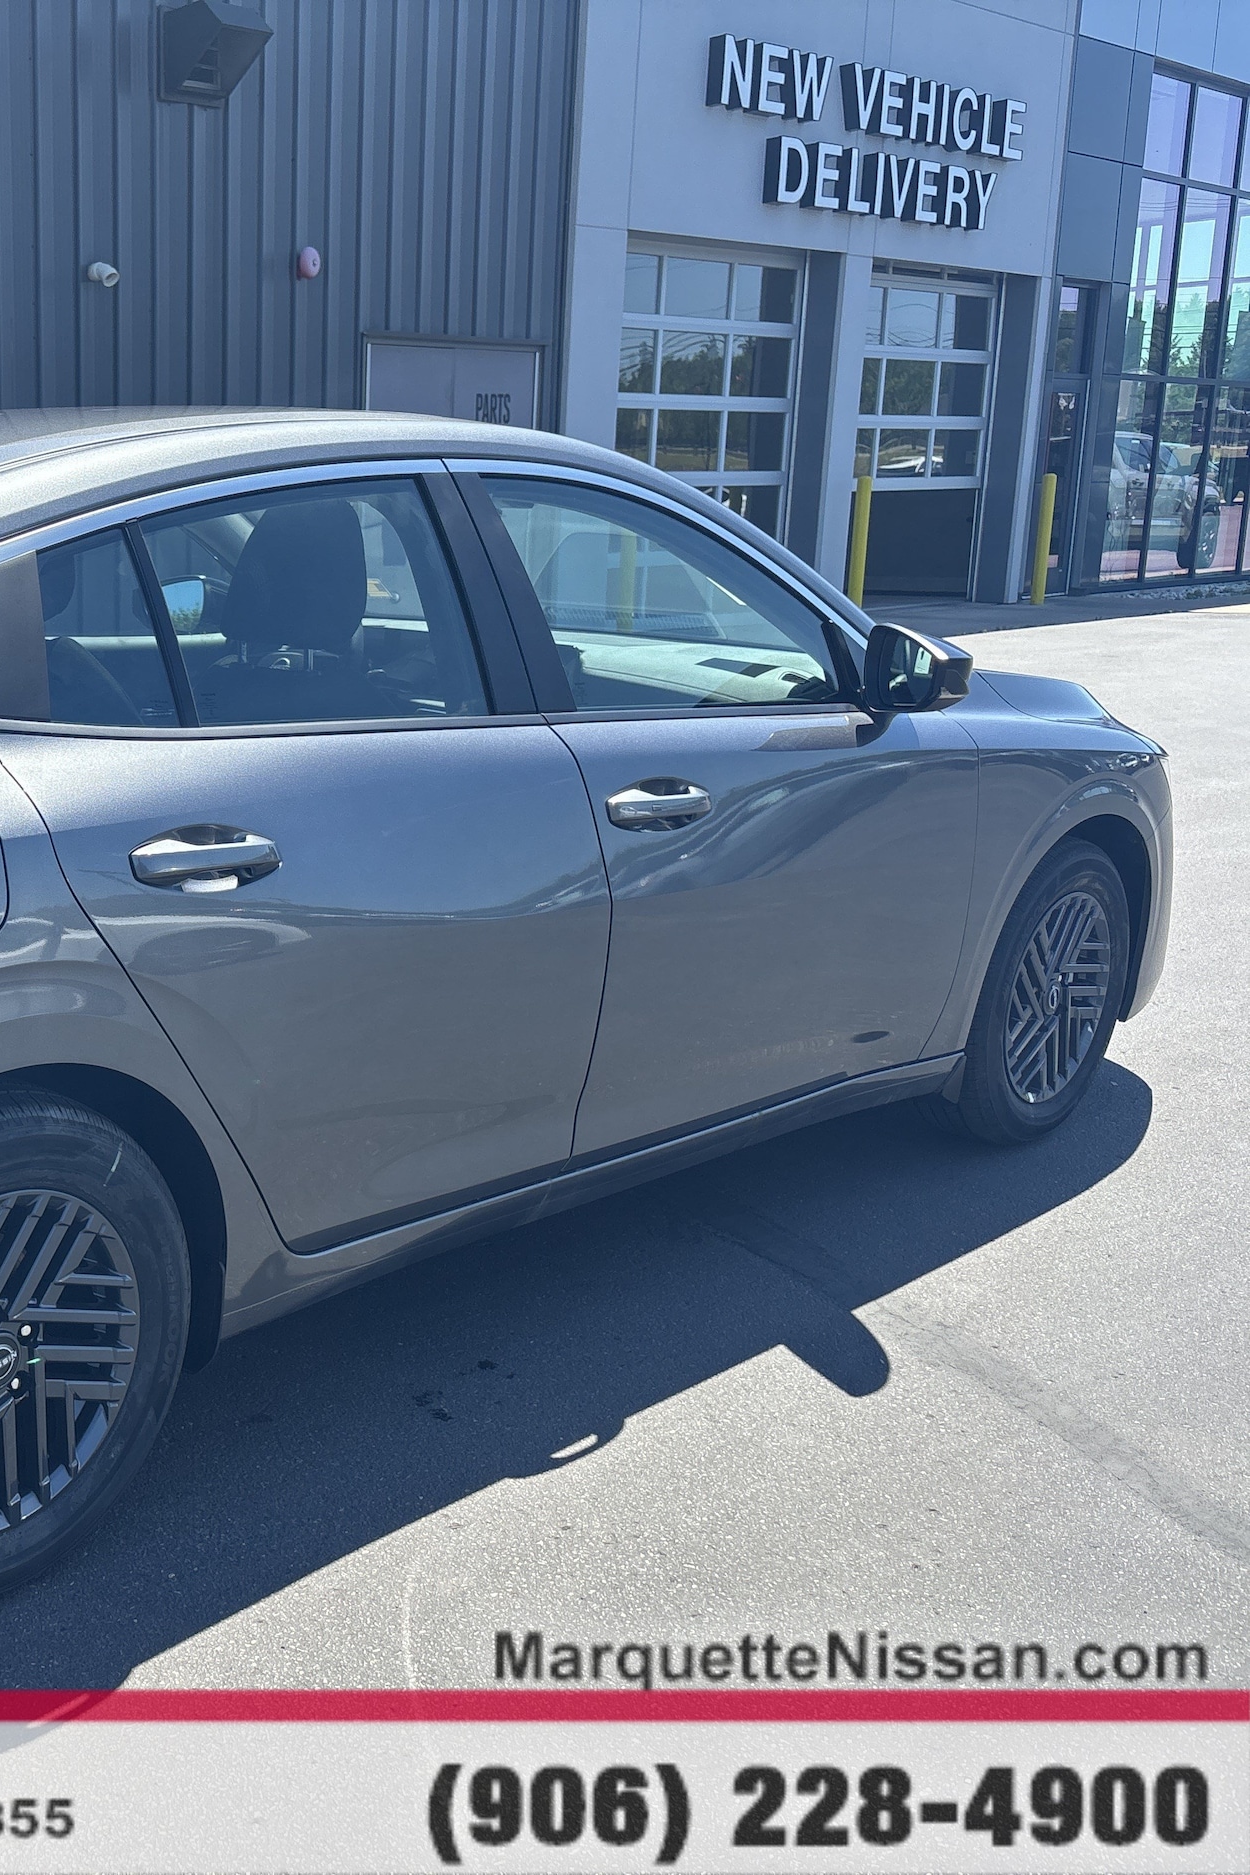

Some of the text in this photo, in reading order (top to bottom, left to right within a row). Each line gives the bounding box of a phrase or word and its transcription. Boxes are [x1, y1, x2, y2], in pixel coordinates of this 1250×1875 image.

[720, 34, 1027, 160] NEW VEHICLE
[777, 136, 998, 230] DELIVERY
[475, 393, 511, 424] PARTS
